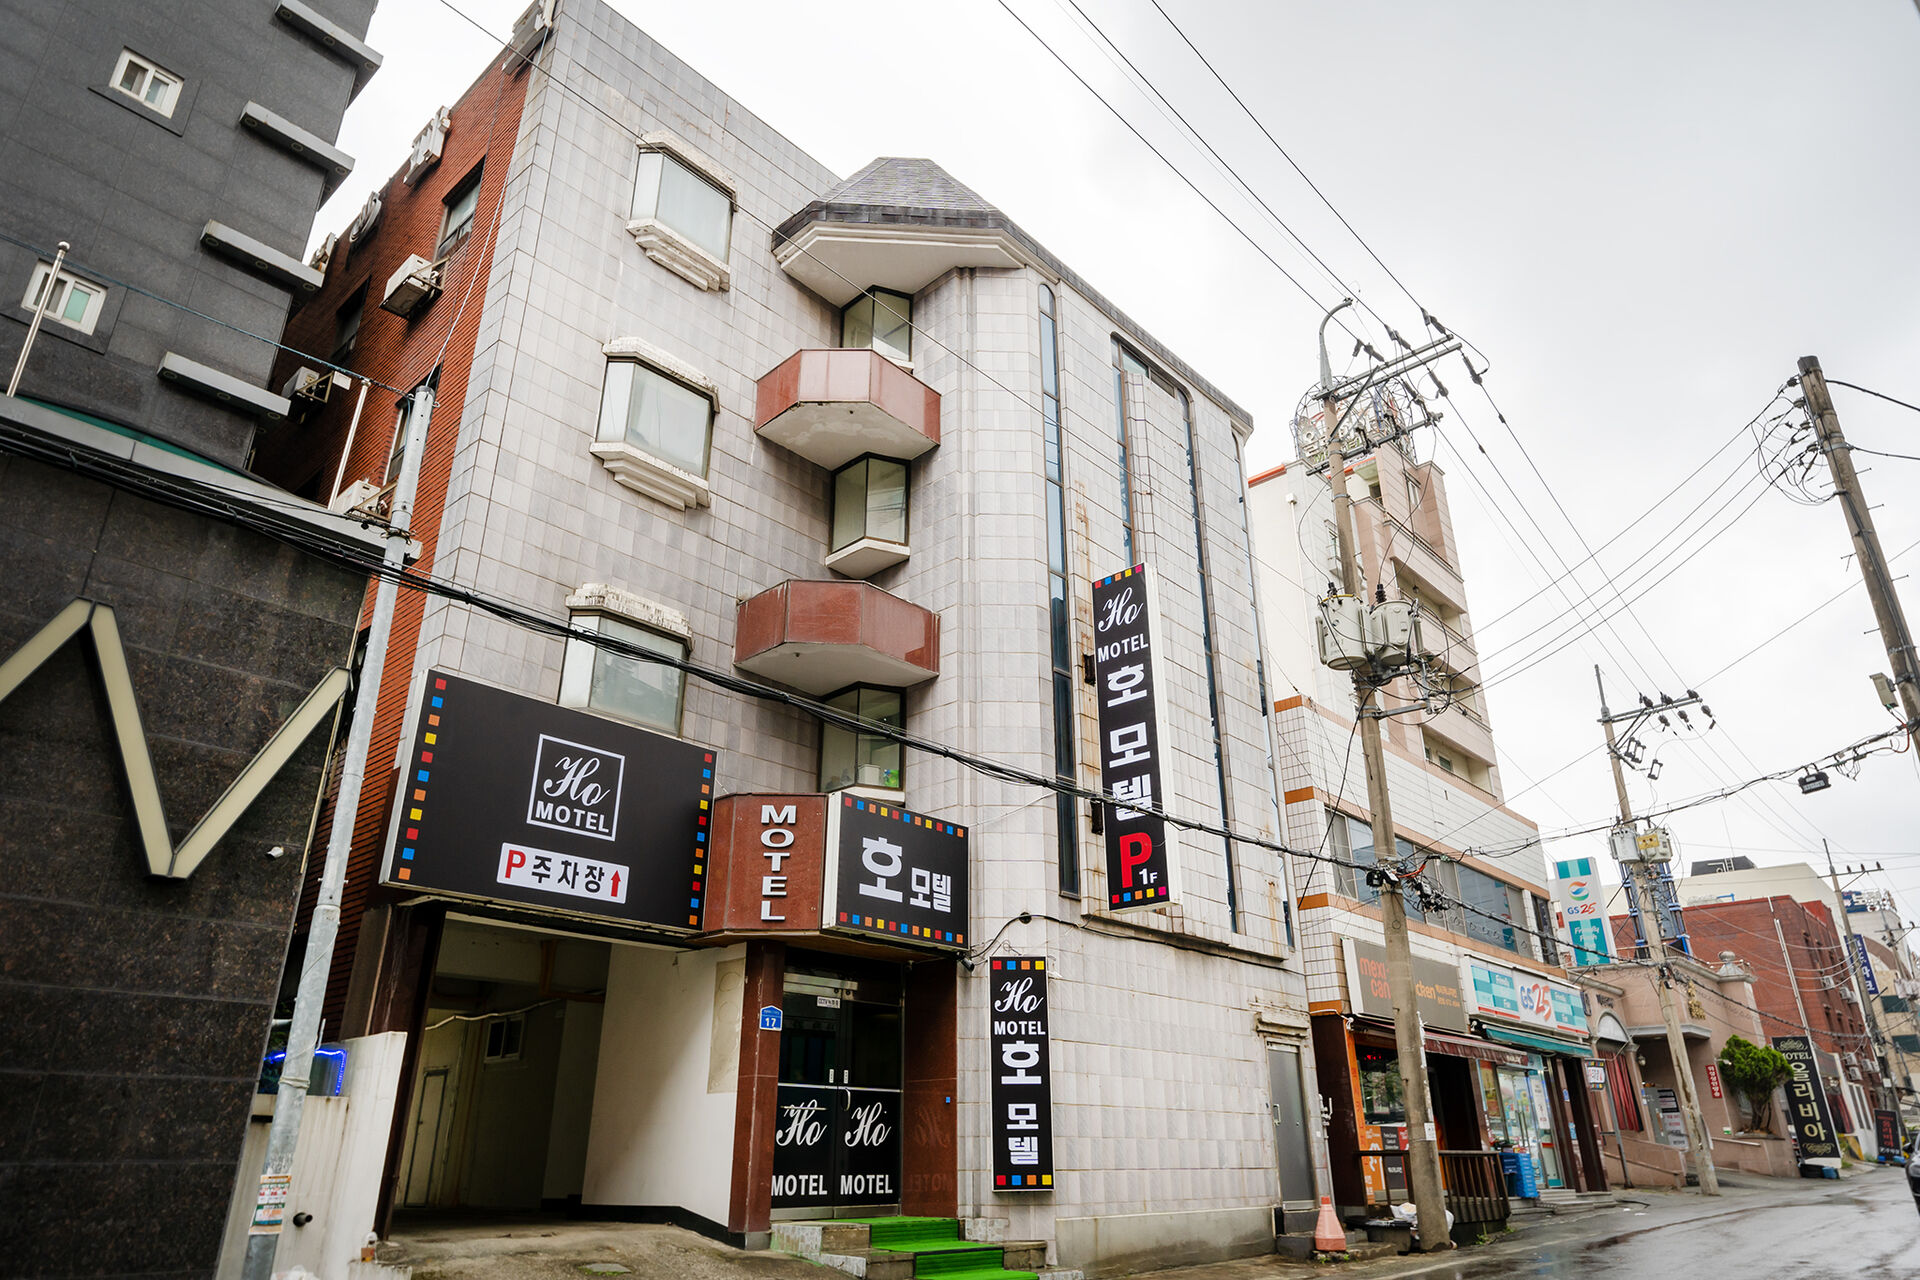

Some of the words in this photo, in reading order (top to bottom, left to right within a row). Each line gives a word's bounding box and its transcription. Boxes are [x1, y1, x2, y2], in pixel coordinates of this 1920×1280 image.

[1097, 587, 1144, 632] Ho
[1097, 633, 1149, 663] MOTEL
[1106, 663, 1148, 708] 호
[542, 755, 611, 807] Ho
[1108, 722, 1154, 821] 모텔
[535, 800, 610, 834] MOTEL
[504, 848, 527, 880] P
[530, 855, 605, 894] 주차장
[760, 804, 797, 922] MOTEL
[858, 836, 904, 903] 호
[909, 867, 953, 913] 모텔
[1118, 831, 1153, 888] P
[1138, 867, 1159, 886] 1F
[1567, 902, 1597, 915] GS25
[994, 976, 1044, 1014] Ho
[1519, 983, 1552, 1022] GS25
[765, 1017, 776, 1028] 17
[993, 1021, 1046, 1036] MOTEL
[1000, 1040, 1042, 1086] 호
[775, 1099, 828, 1147] Ho
[1790, 1062, 1827, 1142] 올리비아
[844, 1102, 892, 1148] Ho
[1006, 1103, 1040, 1166] 모텔
[771, 1175, 828, 1197] MOTEL
[840, 1175, 894, 1196] MOTEL
